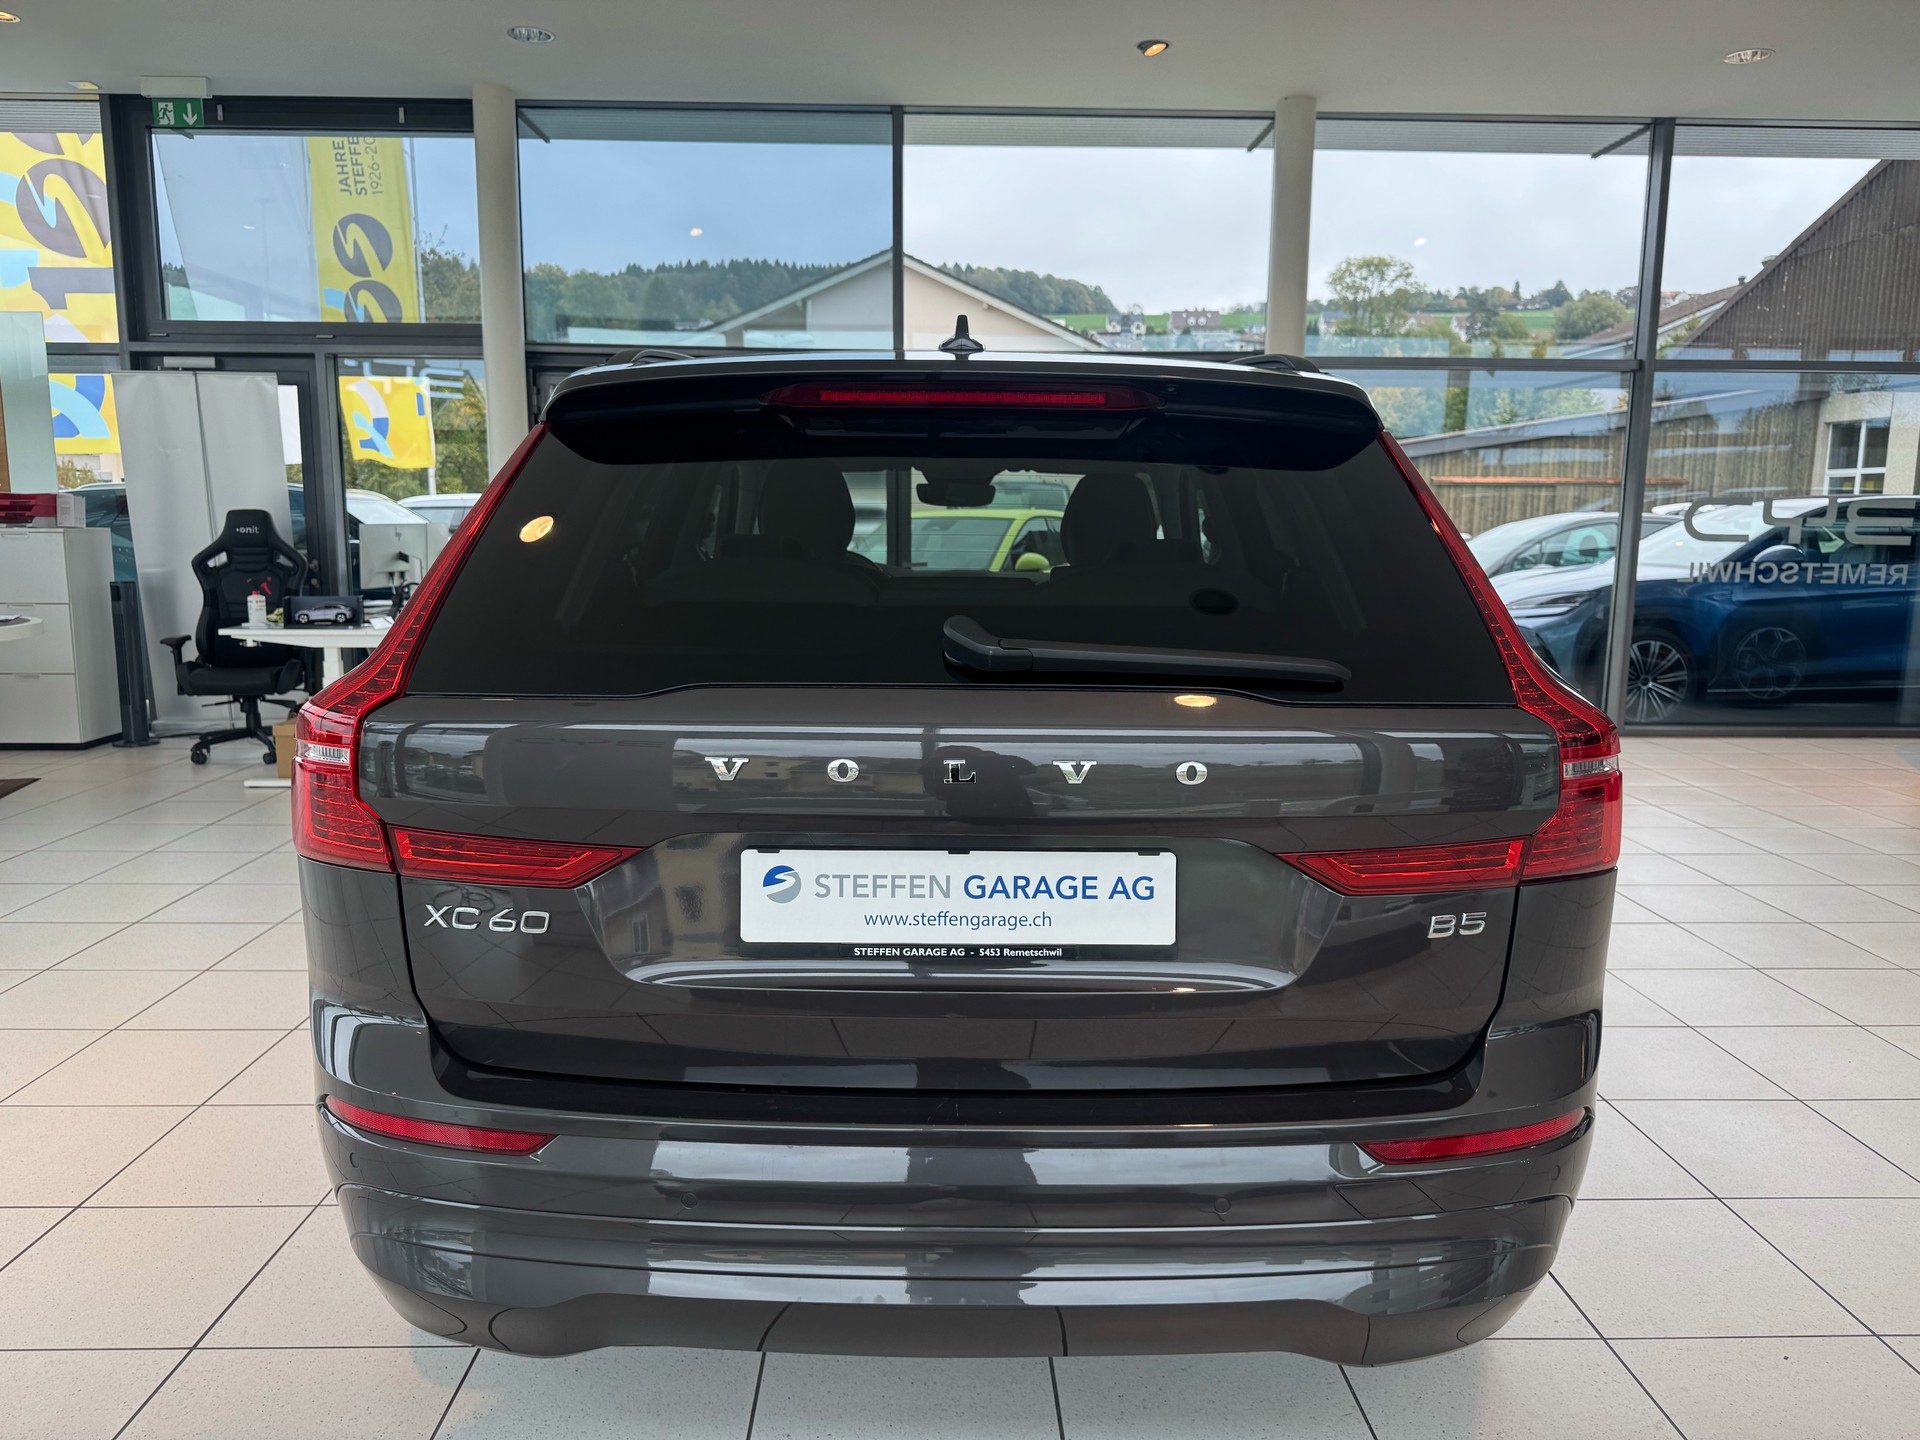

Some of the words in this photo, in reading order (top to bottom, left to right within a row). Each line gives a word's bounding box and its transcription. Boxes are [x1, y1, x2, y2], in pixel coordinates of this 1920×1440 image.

[332, 140, 352, 196] JAHRE
[704, 757, 1208, 786] VOLVO
[814, 873, 951, 899] STEFFEN
[963, 874, 1099, 900] GARAGE
[1107, 875, 1155, 901] AG
[423, 904, 550, 935] XC60
[863, 910, 1052, 931] www.steffengarage.ch
[1427, 911, 1487, 939] B5
[853, 947, 900, 957] STEFFEN
[902, 947, 948, 957] GARAGE
[949, 948, 966, 957] AG
[979, 948, 1001, 957] 5453
[1003, 947, 1063, 958] Remetschwil
